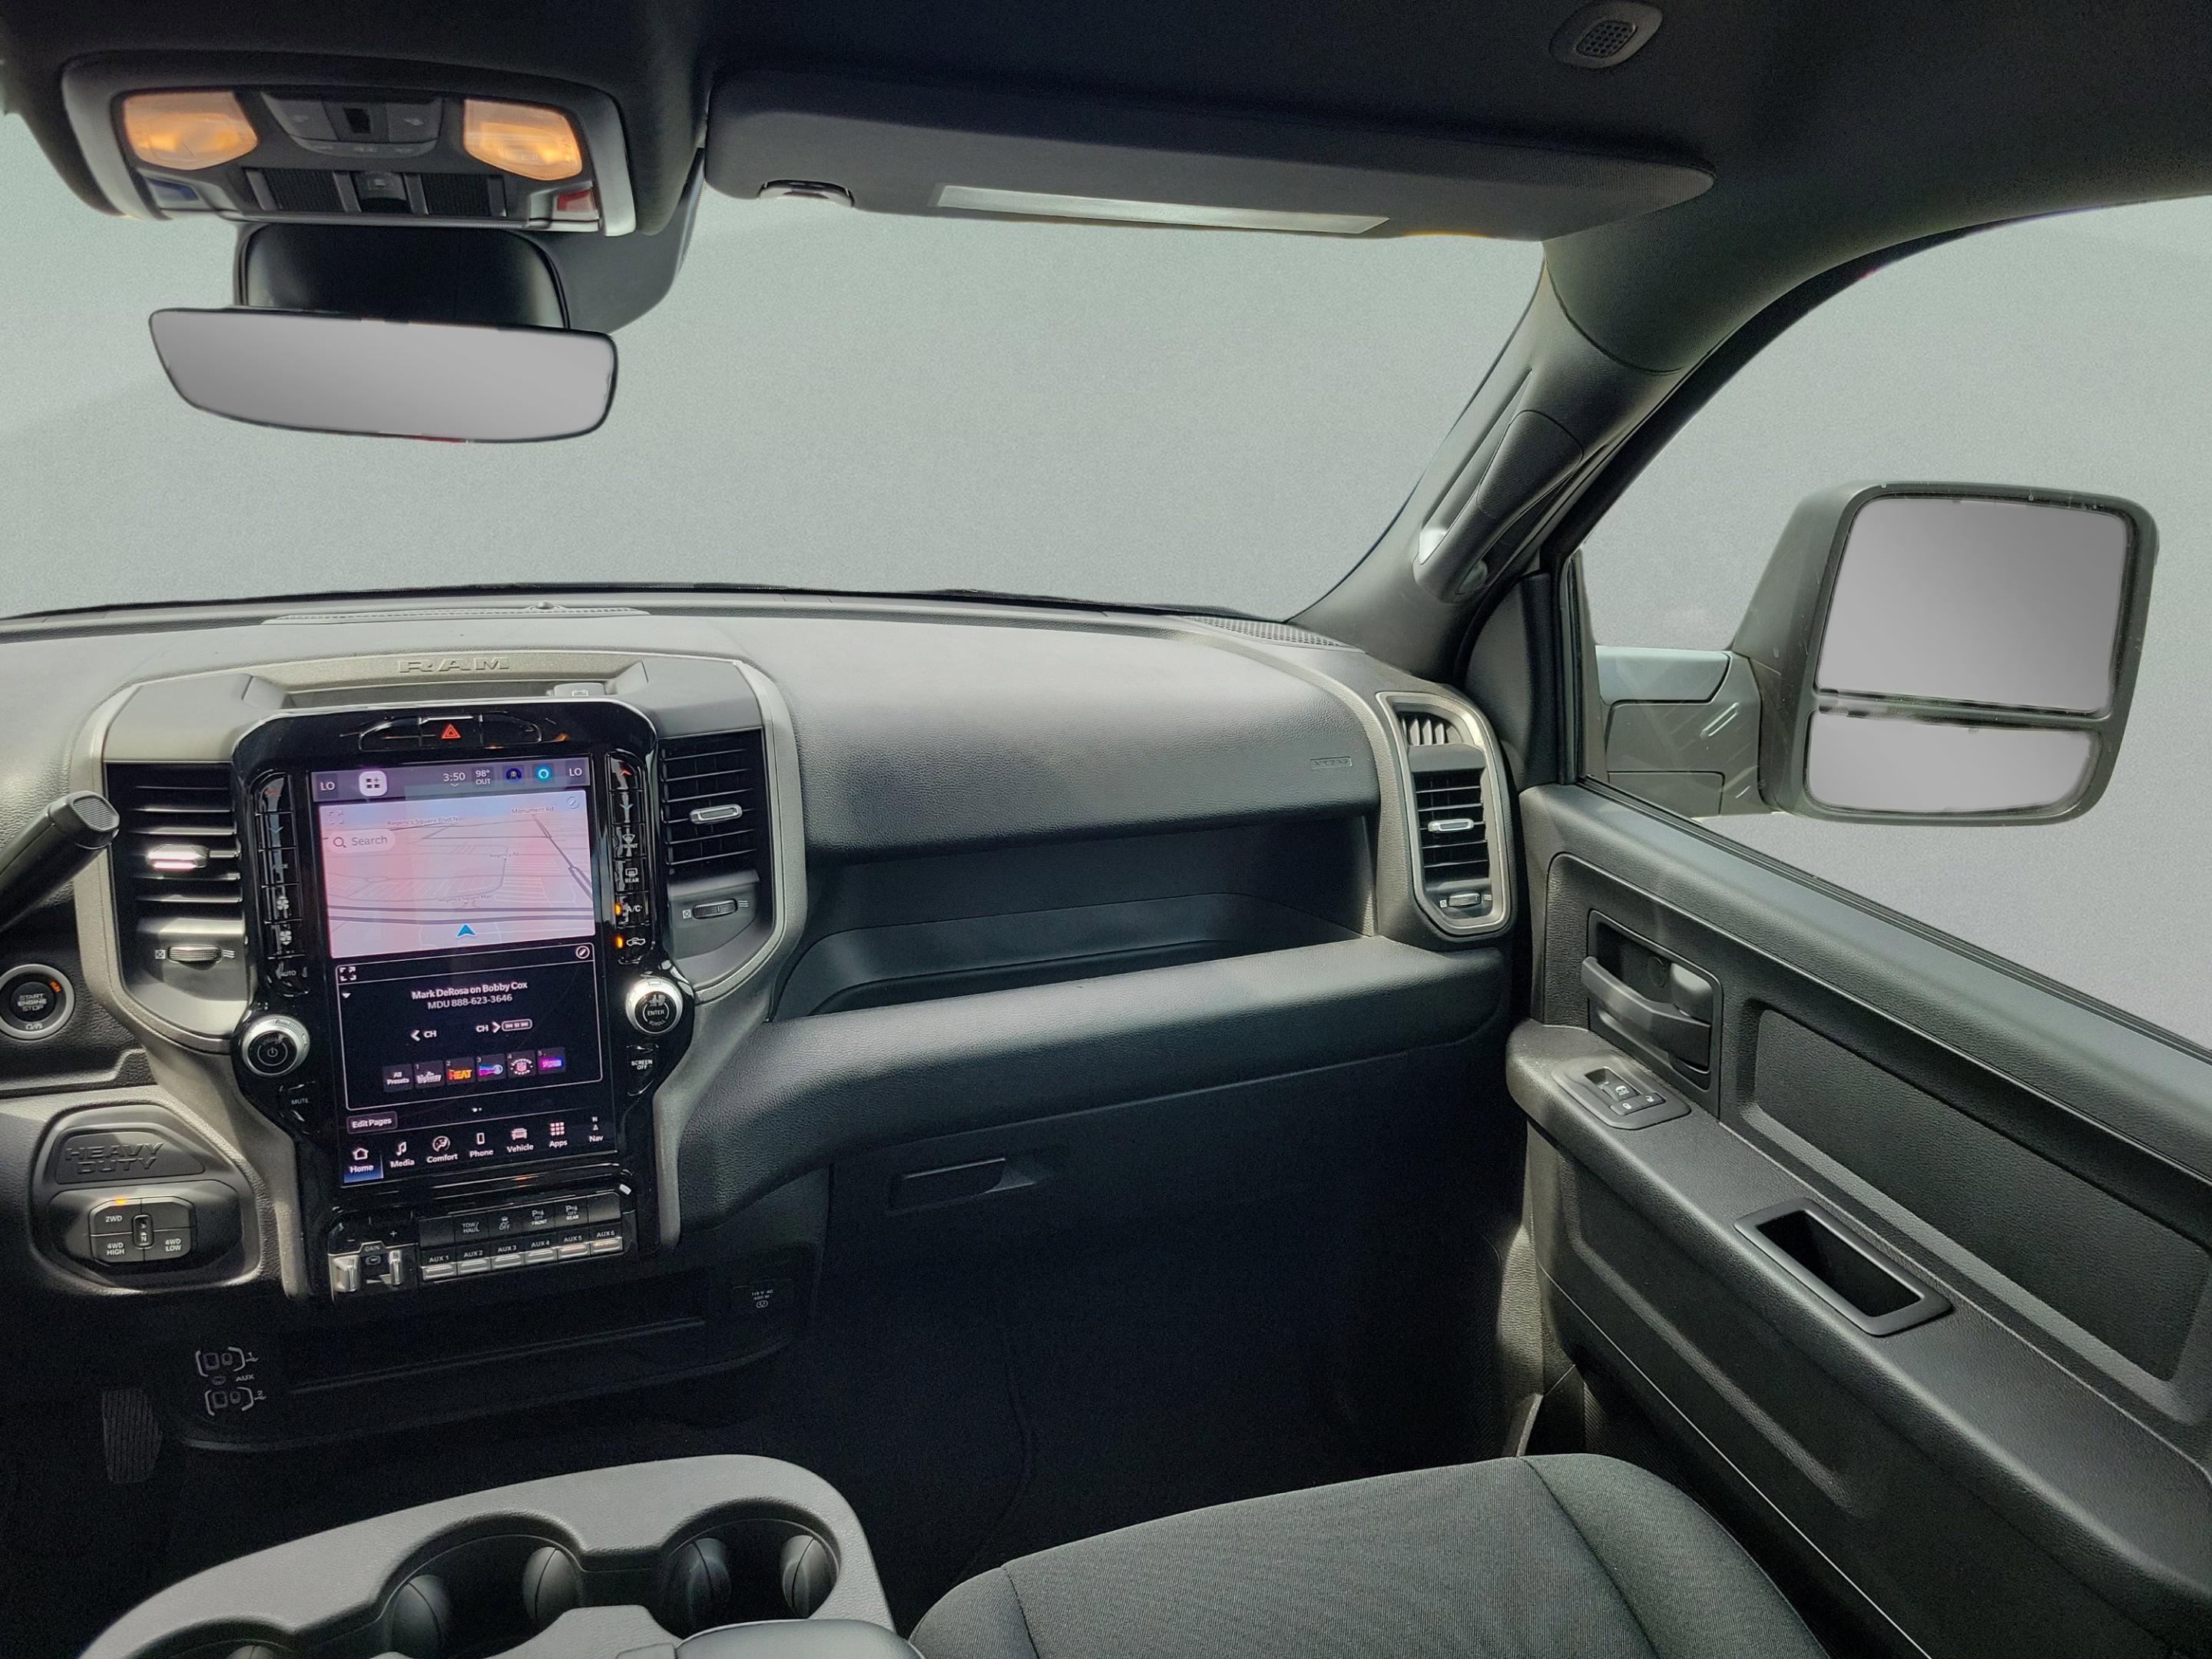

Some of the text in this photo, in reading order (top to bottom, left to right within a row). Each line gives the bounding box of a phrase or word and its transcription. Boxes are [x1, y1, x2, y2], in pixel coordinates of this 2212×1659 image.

[399, 657, 509, 673] RAM
[443, 772, 465, 782] 3:50
[569, 768, 582, 777] LO
[320, 781, 335, 791] LO
[352, 836, 387, 846] Search
[412, 990, 435, 999] Mark
[436, 988, 469, 997] DeRosa
[482, 983, 510, 993] Bobby
[511, 982, 528, 990] Cox
[427, 994, 512, 1010] MDU 888-623-3646
[447, 1069, 472, 1080] HEAT
[352, 1118, 392, 1129] Edit Pages
[507, 1144, 534, 1153] Vehicle
[549, 1140, 568, 1149] Apps
[65, 1143, 164, 1161] HEAVY
[469, 1149, 494, 1157] Phone
[390, 1159, 415, 1167] Media
[426, 1154, 458, 1163] Comfort
[77, 1157, 157, 1174] DUTY
[349, 1164, 374, 1173] Home
[236, 1373, 255, 1382] AUX
